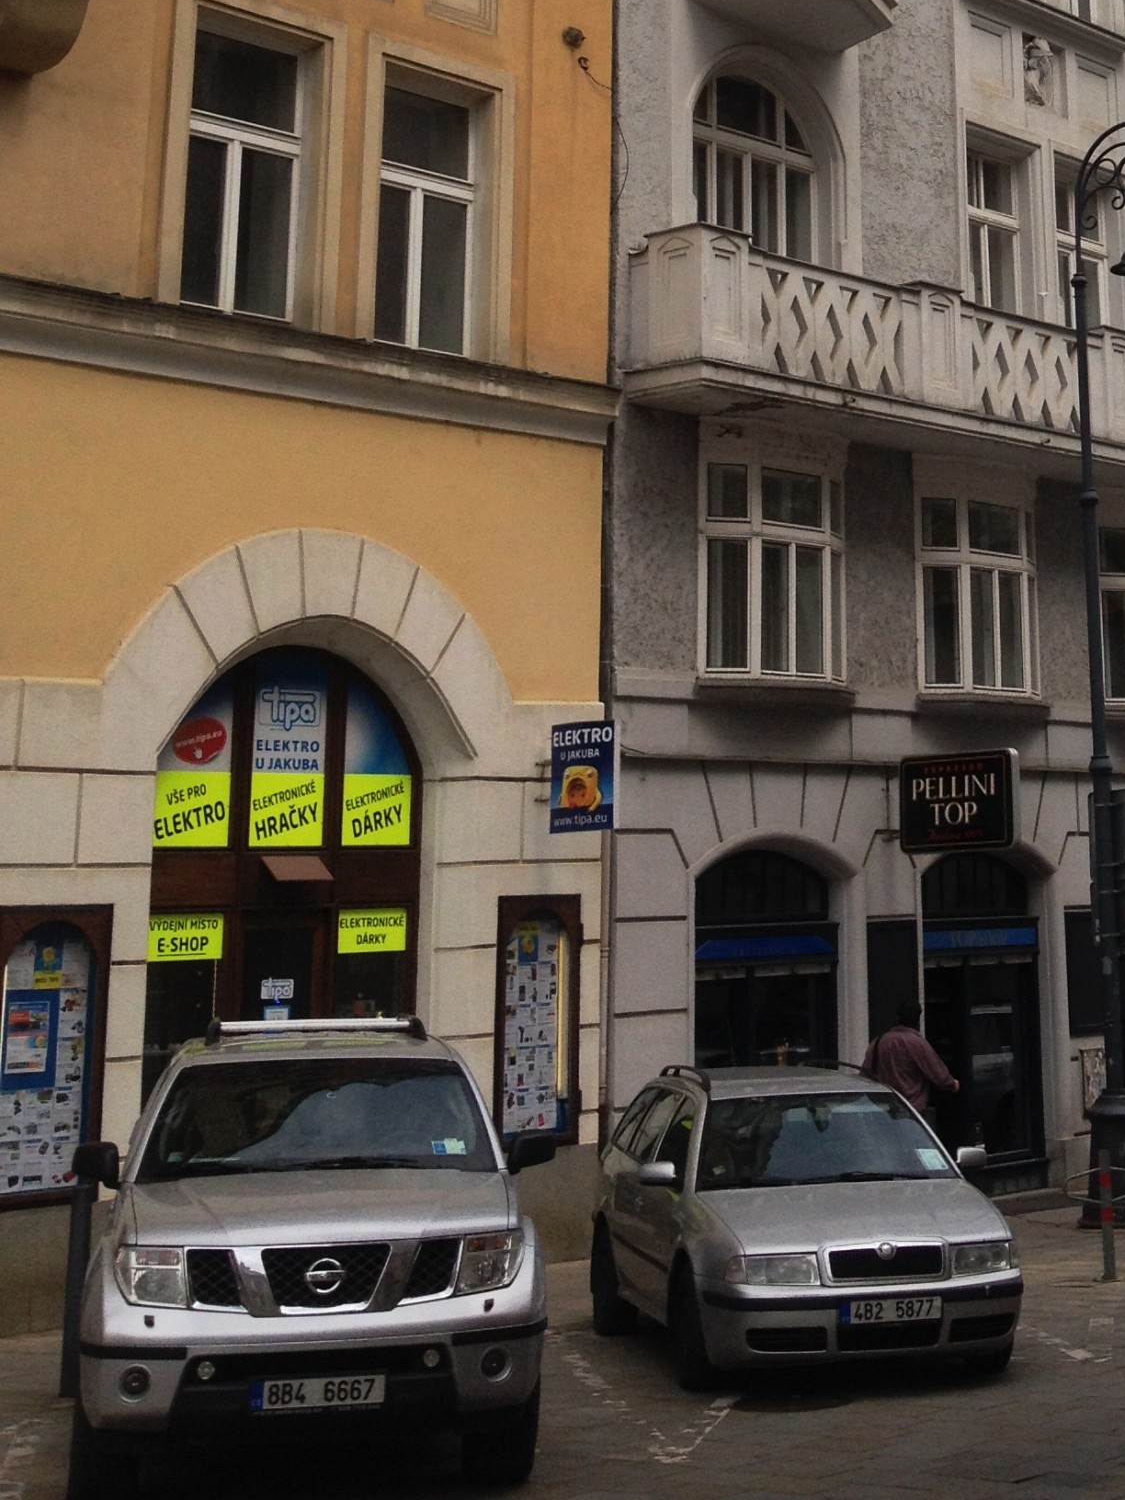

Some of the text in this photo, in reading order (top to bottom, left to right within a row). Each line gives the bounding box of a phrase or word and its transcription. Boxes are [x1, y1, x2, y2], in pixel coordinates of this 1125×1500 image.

[260, 686, 318, 731] tipa
[256, 739, 320, 753] ELEKTRO
[552, 726, 613, 747] ELEKTRO
[255, 757, 319, 771] U JAKUBA
[560, 748, 600, 761] U JAKUBA
[166, 783, 207, 806] VŠE PRO
[252, 779, 316, 812] ELEKTRONICKÉ
[345, 780, 405, 812] ELEKTRONICKÉ
[912, 773, 996, 801] PELLINI
[154, 800, 226, 840] ELEKTRO
[255, 802, 318, 841] HRAČKY
[352, 804, 403, 838] DÁRKY
[553, 814, 608, 827] www.tipa.eu
[929, 801, 978, 826] TOP
[149, 917, 218, 932] VÝDEJNÍ MÍSTO
[339, 914, 404, 929] ELEKTRONICKÉ
[157, 936, 209, 953] E-SHOP
[356, 931, 386, 945] DÁRKY
[854, 1300, 934, 1321] 4B2 5877
[268, 1378, 375, 1405] 8B4 6667
